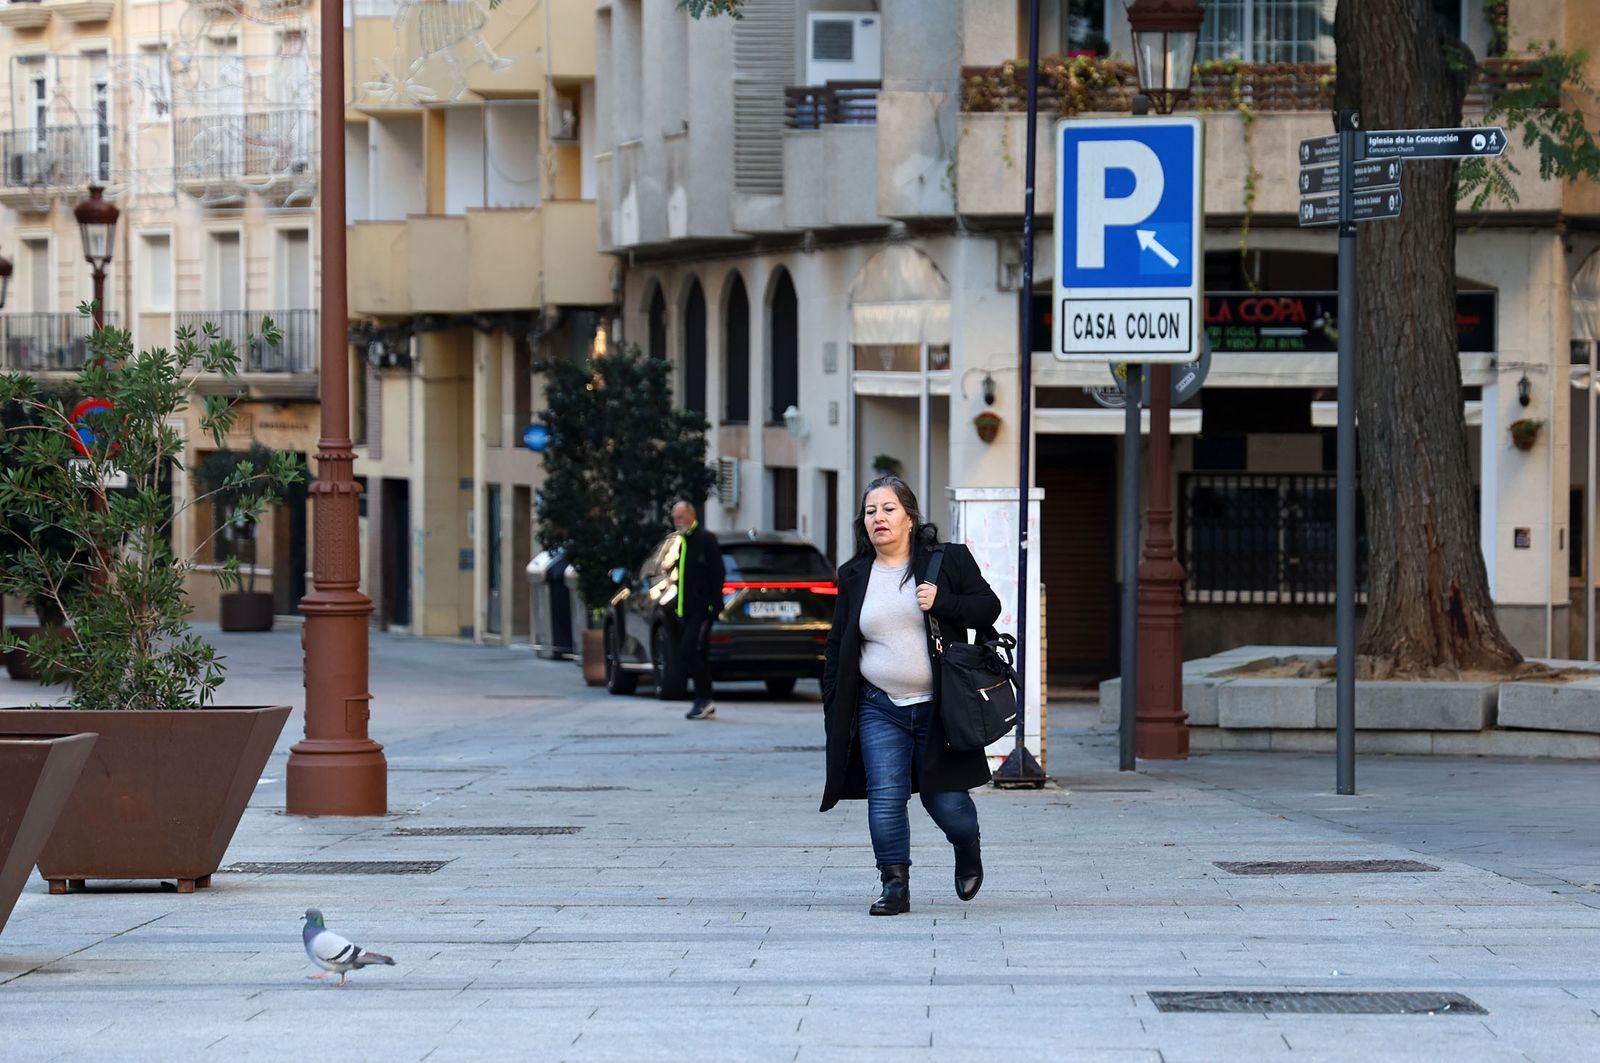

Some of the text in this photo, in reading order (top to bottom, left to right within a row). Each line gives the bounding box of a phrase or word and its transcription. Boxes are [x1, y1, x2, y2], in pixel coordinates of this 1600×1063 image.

[1369, 134, 1459, 146] Iglesia de la Concepción
[1076, 139, 1165, 269] P
[1204, 297, 1307, 322] LA COPA
[1073, 312, 1180, 340] CASA COLON
